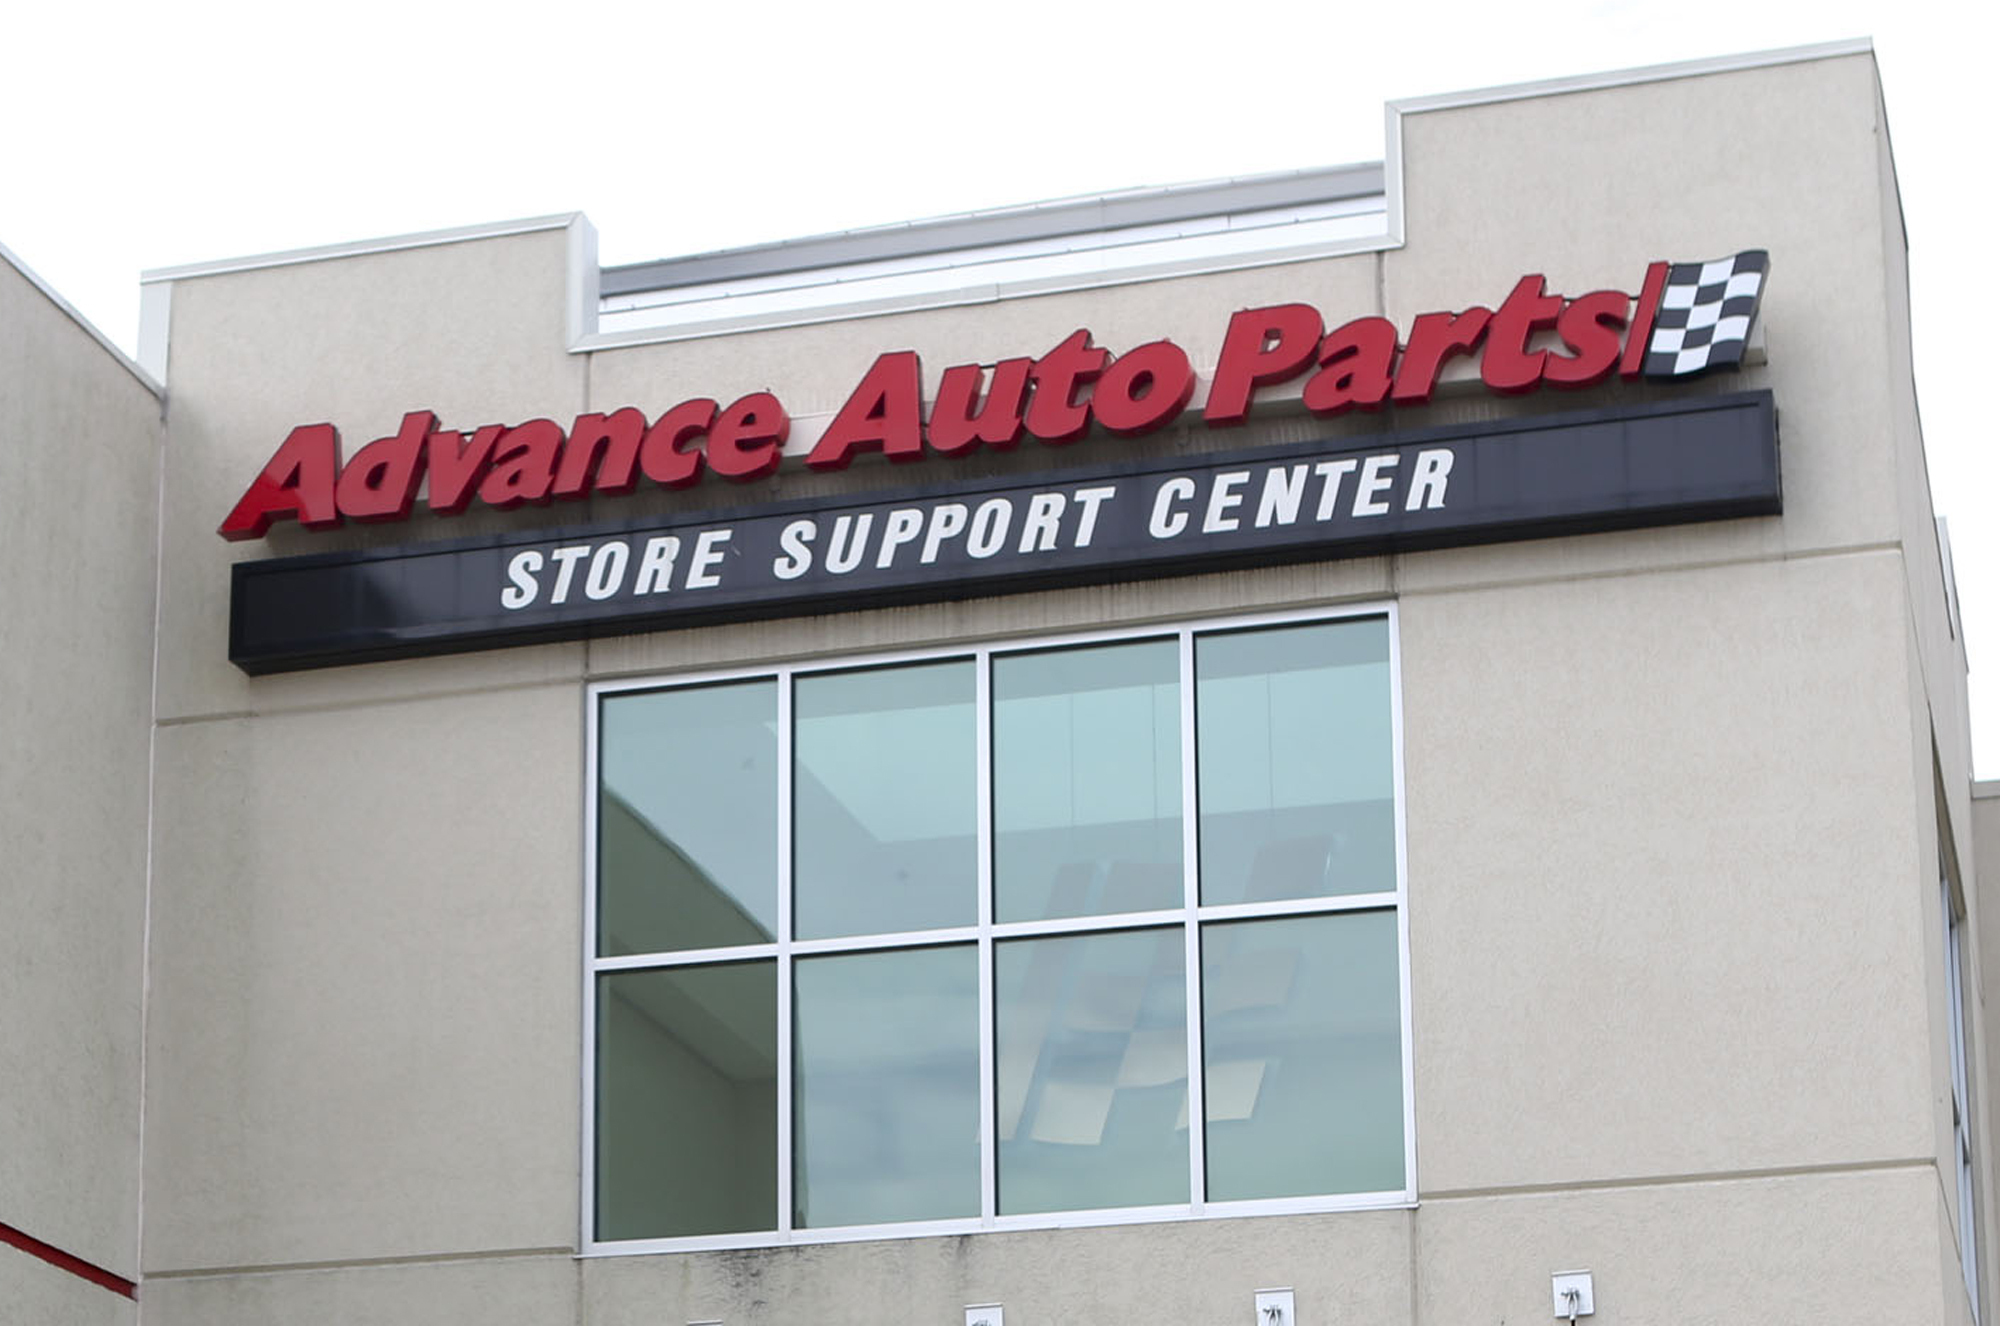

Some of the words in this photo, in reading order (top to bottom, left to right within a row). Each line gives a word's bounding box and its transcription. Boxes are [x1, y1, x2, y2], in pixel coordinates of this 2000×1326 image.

[217, 389, 789, 541] Advance
[805, 328, 1195, 469] Auto
[1204, 273, 1630, 427] Parts
[501, 528, 733, 611] STORE
[772, 485, 1116, 581] SUPPORT
[1148, 447, 1455, 540] CENTER
